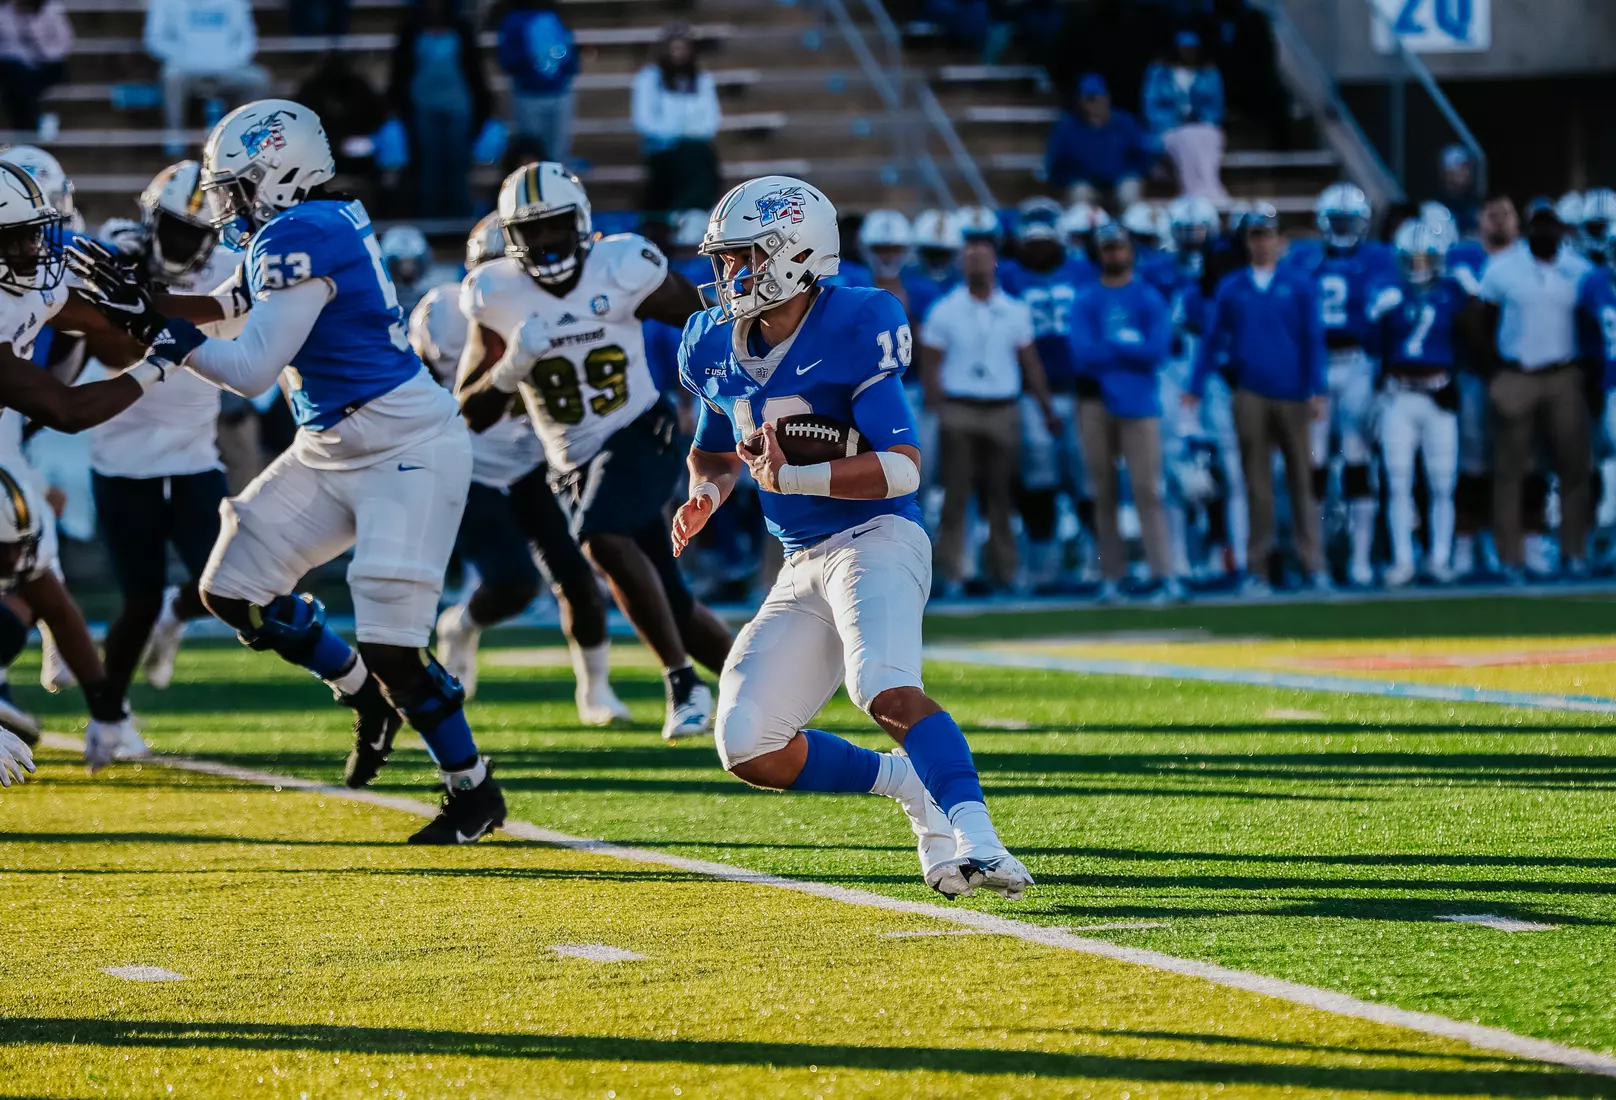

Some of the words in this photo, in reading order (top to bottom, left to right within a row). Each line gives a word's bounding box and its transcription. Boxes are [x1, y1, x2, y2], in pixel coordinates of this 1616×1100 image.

[261, 252, 312, 289] 53
[1322, 275, 1347, 325] 2
[876, 324, 913, 371] 18
[531, 345, 630, 425] 89
[711, 368, 728, 376] USA
